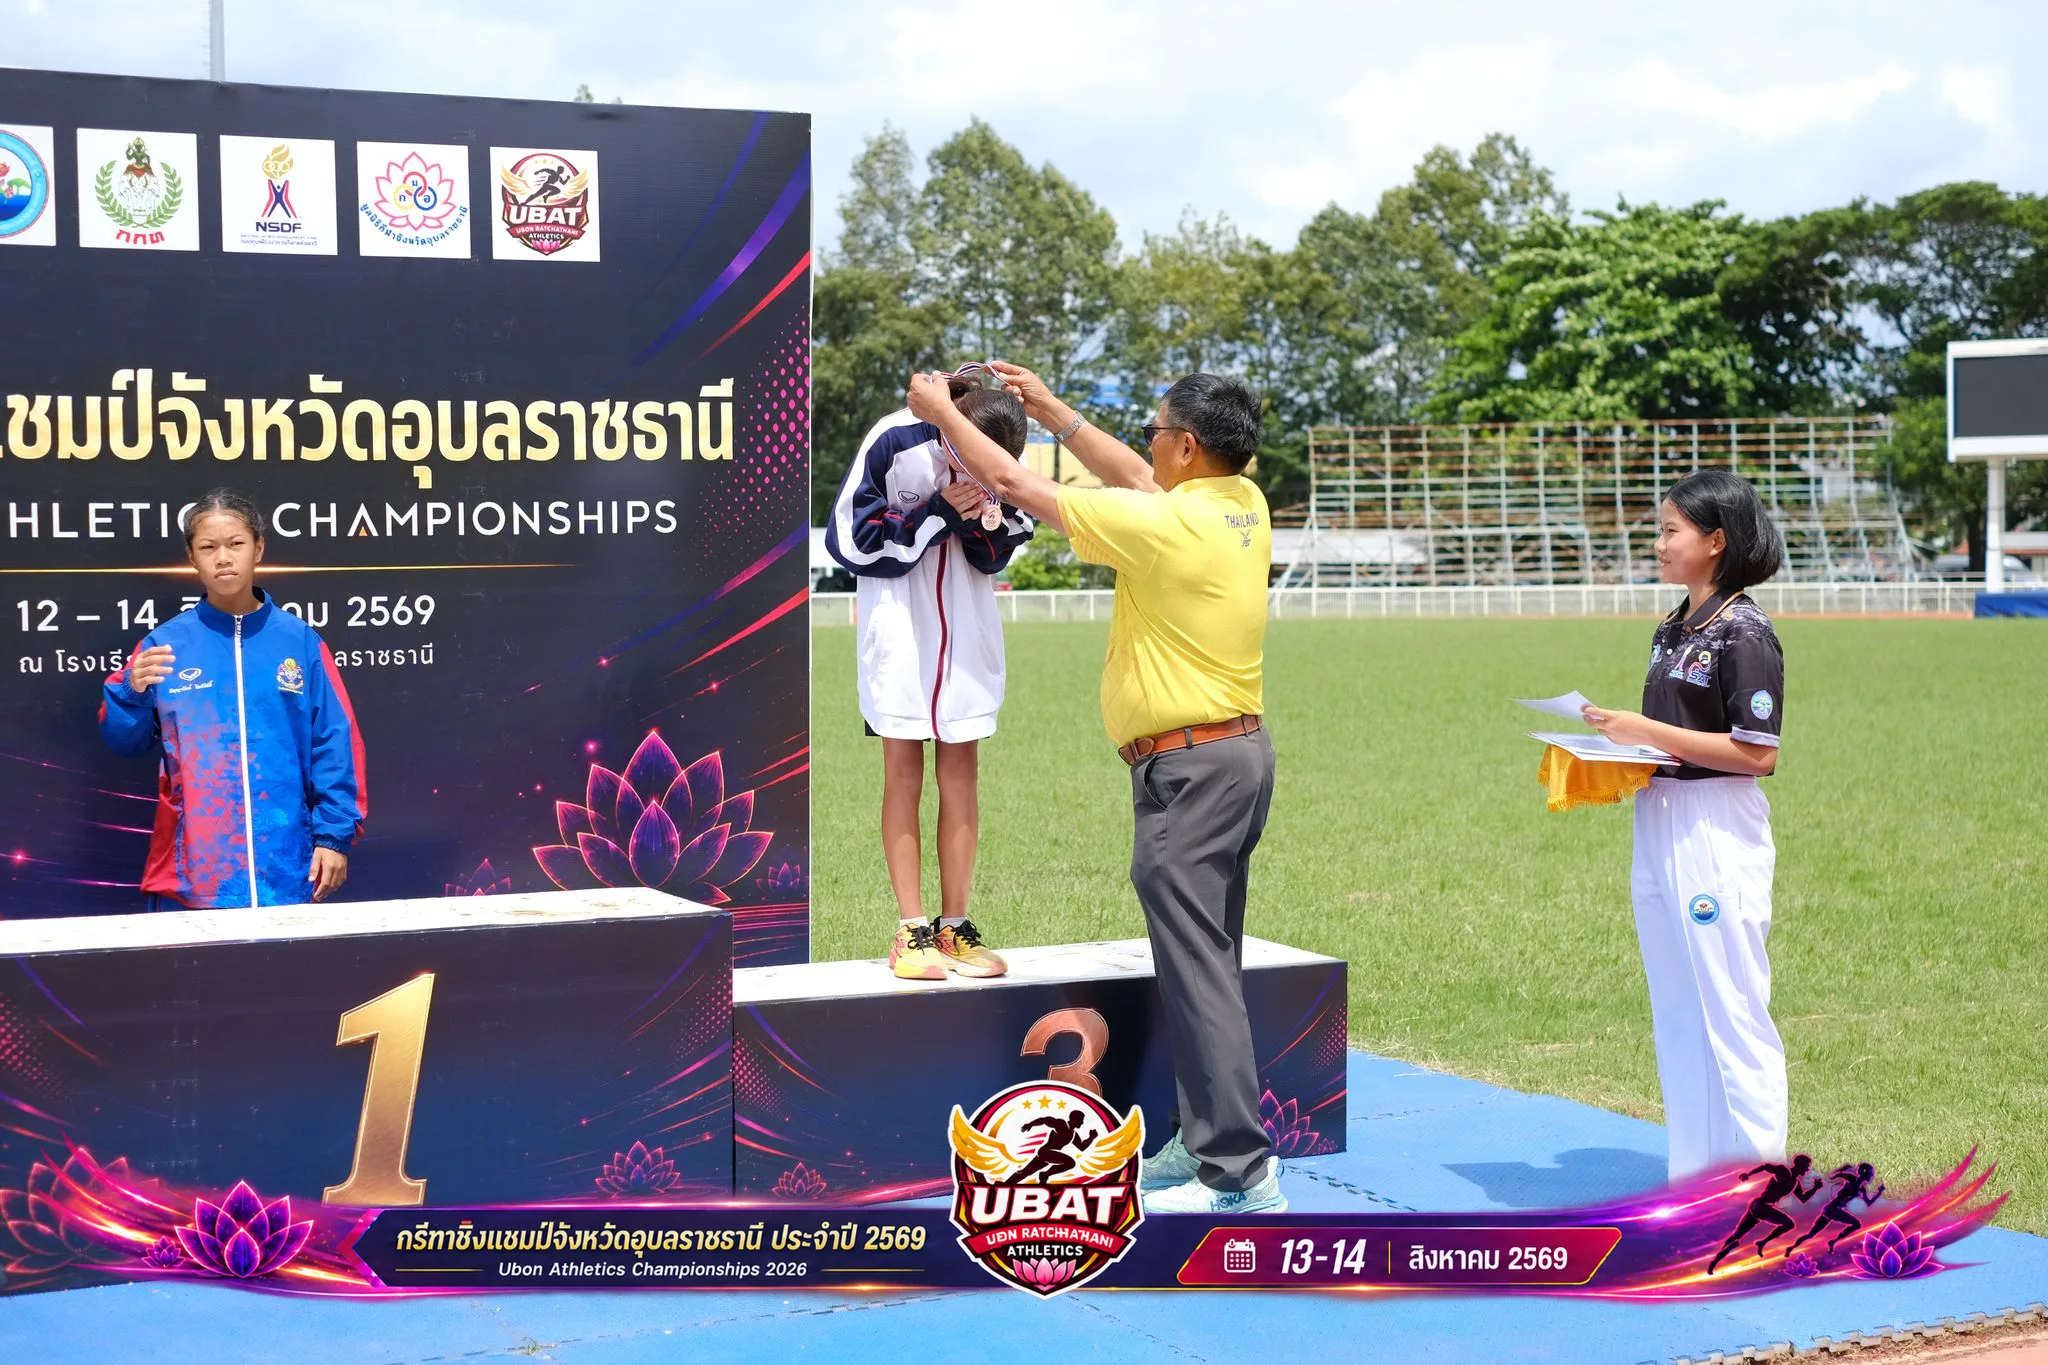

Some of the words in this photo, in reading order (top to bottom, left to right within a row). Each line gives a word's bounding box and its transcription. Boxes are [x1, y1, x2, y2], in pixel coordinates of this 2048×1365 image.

[509, 204, 583, 226] UBAT
[255, 221, 302, 233] NSDF
[0, 367, 735, 490] ชมป์จังหวัดอุบลราชธานี
[271, 500, 678, 538] CHAMPIONSHIPS
[1224, 512, 1259, 529] THAILAND
[16, 599, 59, 632] 12
[117, 598, 159, 631] 14
[347, 594, 436, 627] 2569
[19, 656, 42, 674] ณ
[321, 972, 434, 1207] 1
[1209, 1192, 1248, 1213] HOKA
